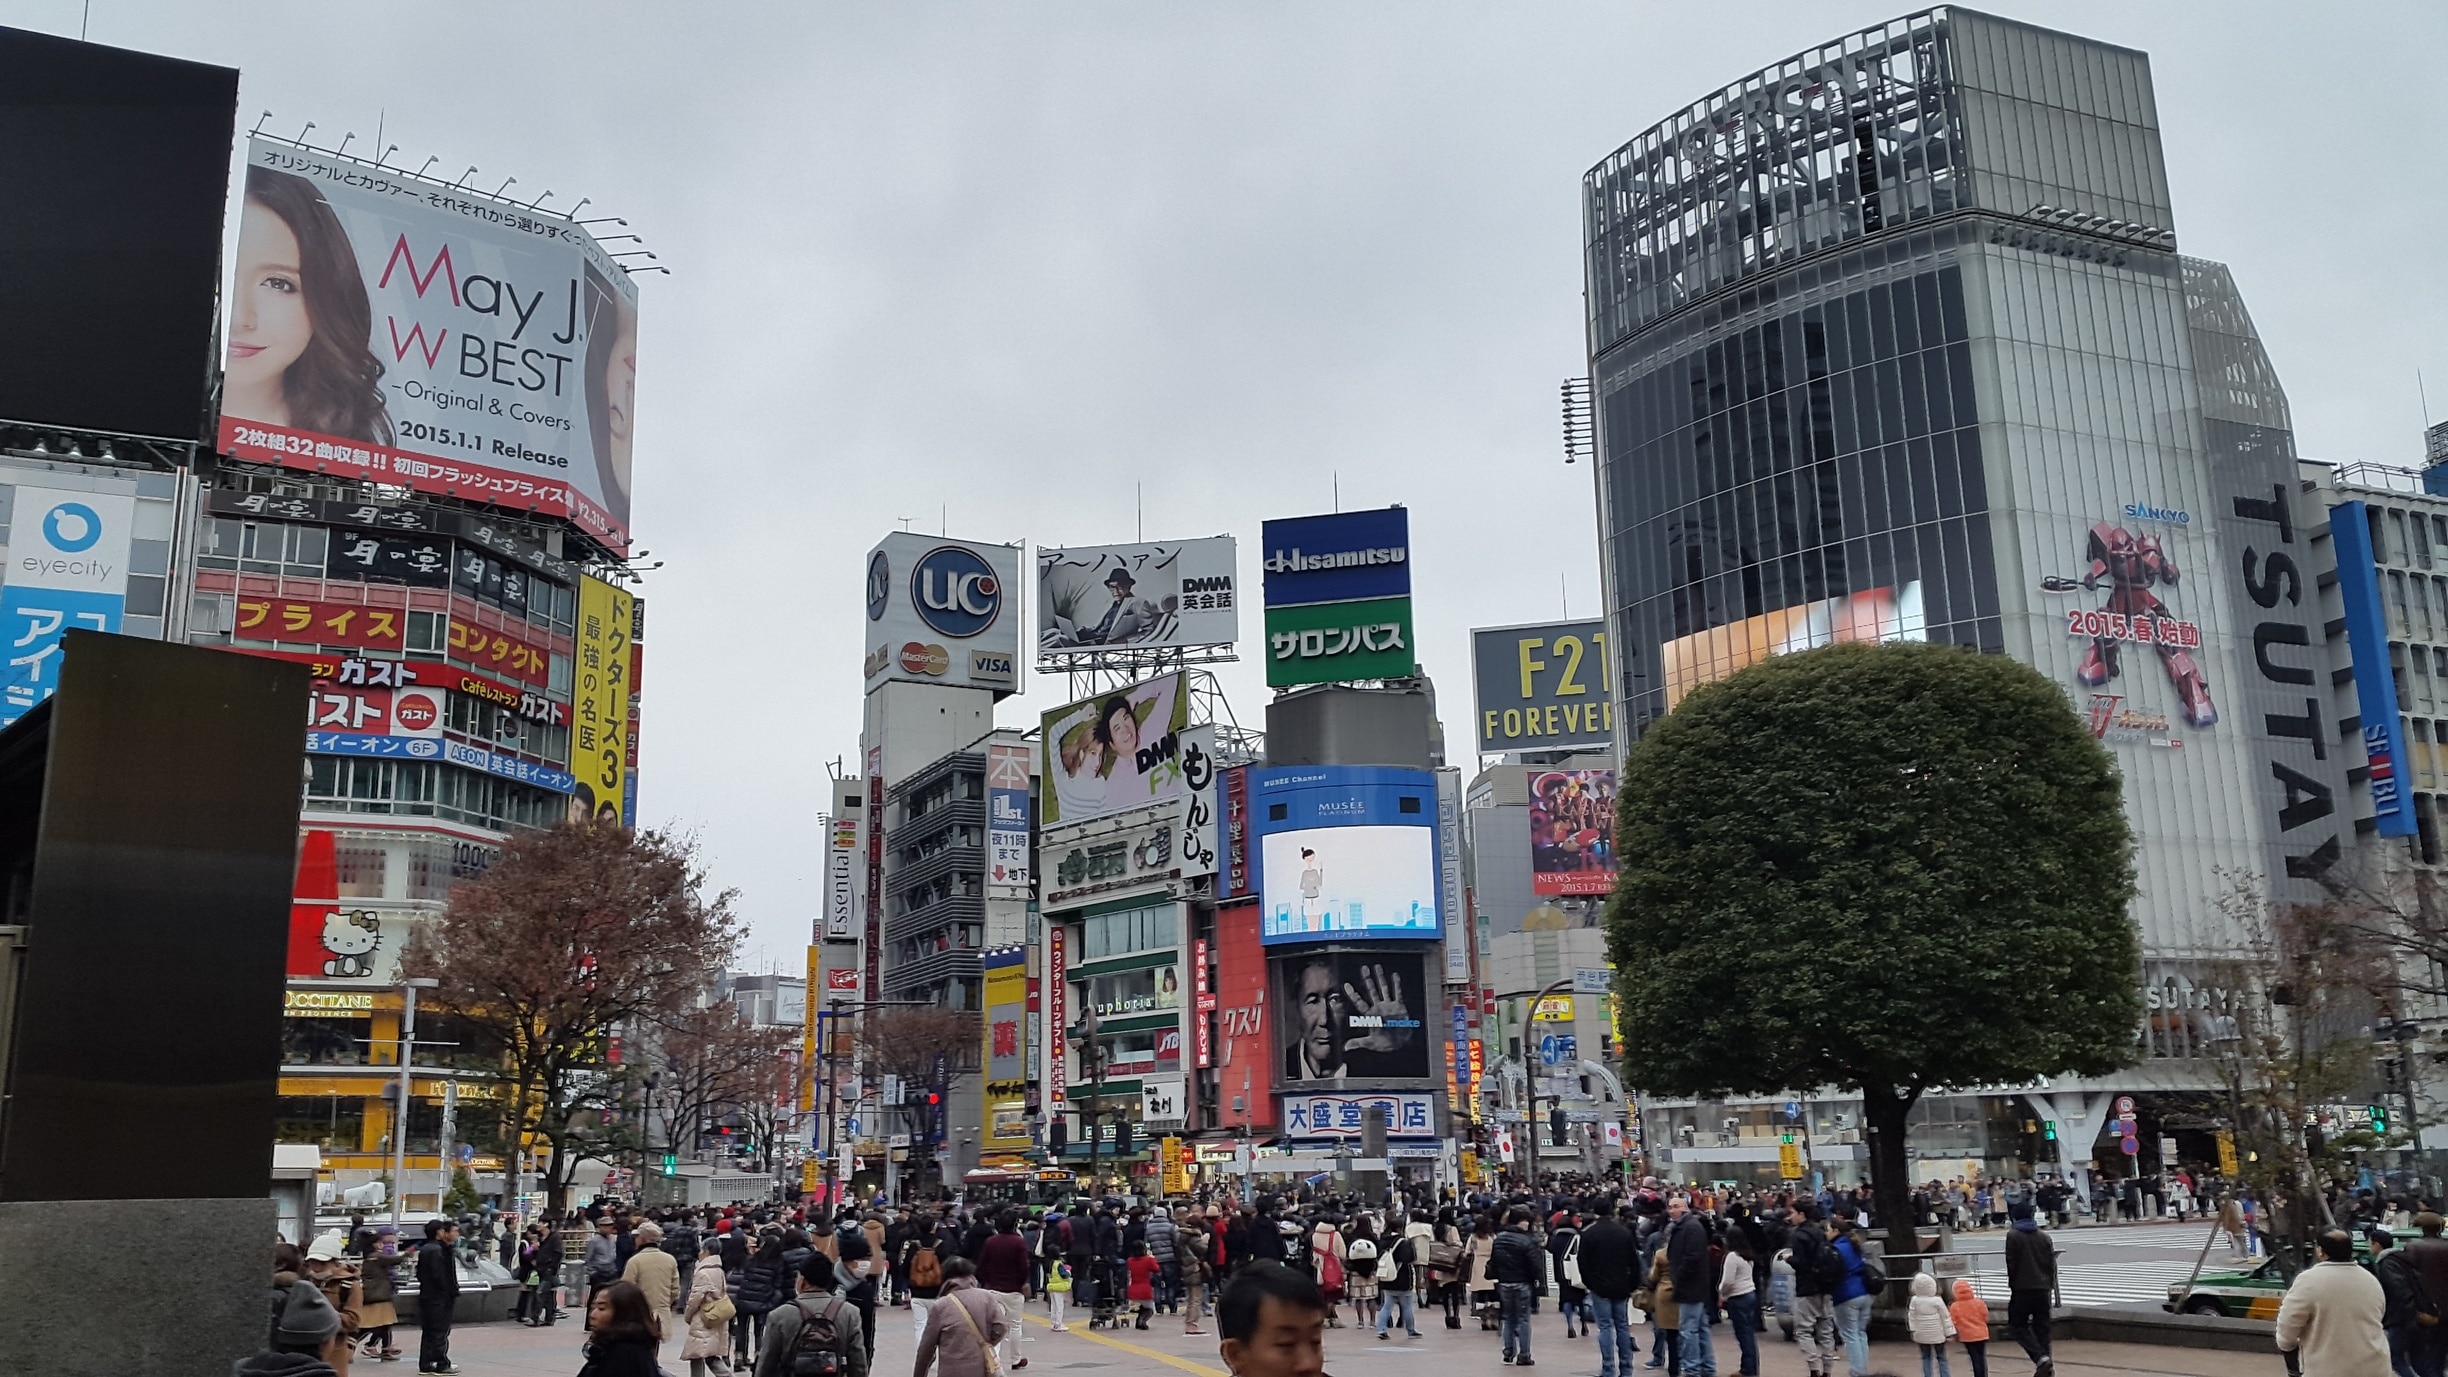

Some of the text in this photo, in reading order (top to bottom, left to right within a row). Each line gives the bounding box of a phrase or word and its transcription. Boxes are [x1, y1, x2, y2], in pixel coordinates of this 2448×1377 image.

[379, 233, 584, 344] May J.
[388, 316, 573, 396] W BEST
[488, 399, 503, 416] &
[399, 421, 569, 469] 2015.1.1 Release
[2125, 501, 2189, 523] SANKYO
[22, 556, 113, 582] eyecity
[1264, 547, 1405, 573] Hisamitsu
[1183, 576, 1232, 593] DMM
[1183, 592, 1231, 610] 英会話
[239, 602, 398, 638] プライス
[2158, 618, 2200, 647] 始動
[448, 621, 545, 675] コンタクト
[1271, 622, 1404, 659] サロンパス
[901, 652, 948, 665] MasterCard
[975, 658, 1011, 674] VISA
[340, 658, 417, 687] ガスト
[579, 614, 602, 752] 最強の名医
[2233, 483, 2341, 878] TSUTAY
[401, 709, 433, 721] ガスト
[520, 692, 563, 725] ガスト
[412, 742, 431, 754] 6F
[451, 744, 573, 789] AEON 英会話イーオン
[990, 747, 1029, 789] 本
[1292, 774, 1326, 783] Channel
[2365, 724, 2400, 817] SEIBU
[1182, 742, 1214, 870] もんじゃ
[992, 833, 1027, 847] 夜11時
[998, 848, 1020, 861] まで
[1009, 868, 1027, 881] 地下
[1538, 873, 1571, 883] NEWS
[831, 849, 849, 936] Essential
[1098, 997, 1152, 1016] uphoria
[1349, 1014, 1421, 1029] DMM.make
[1159, 1031, 1179, 1054] JTB
